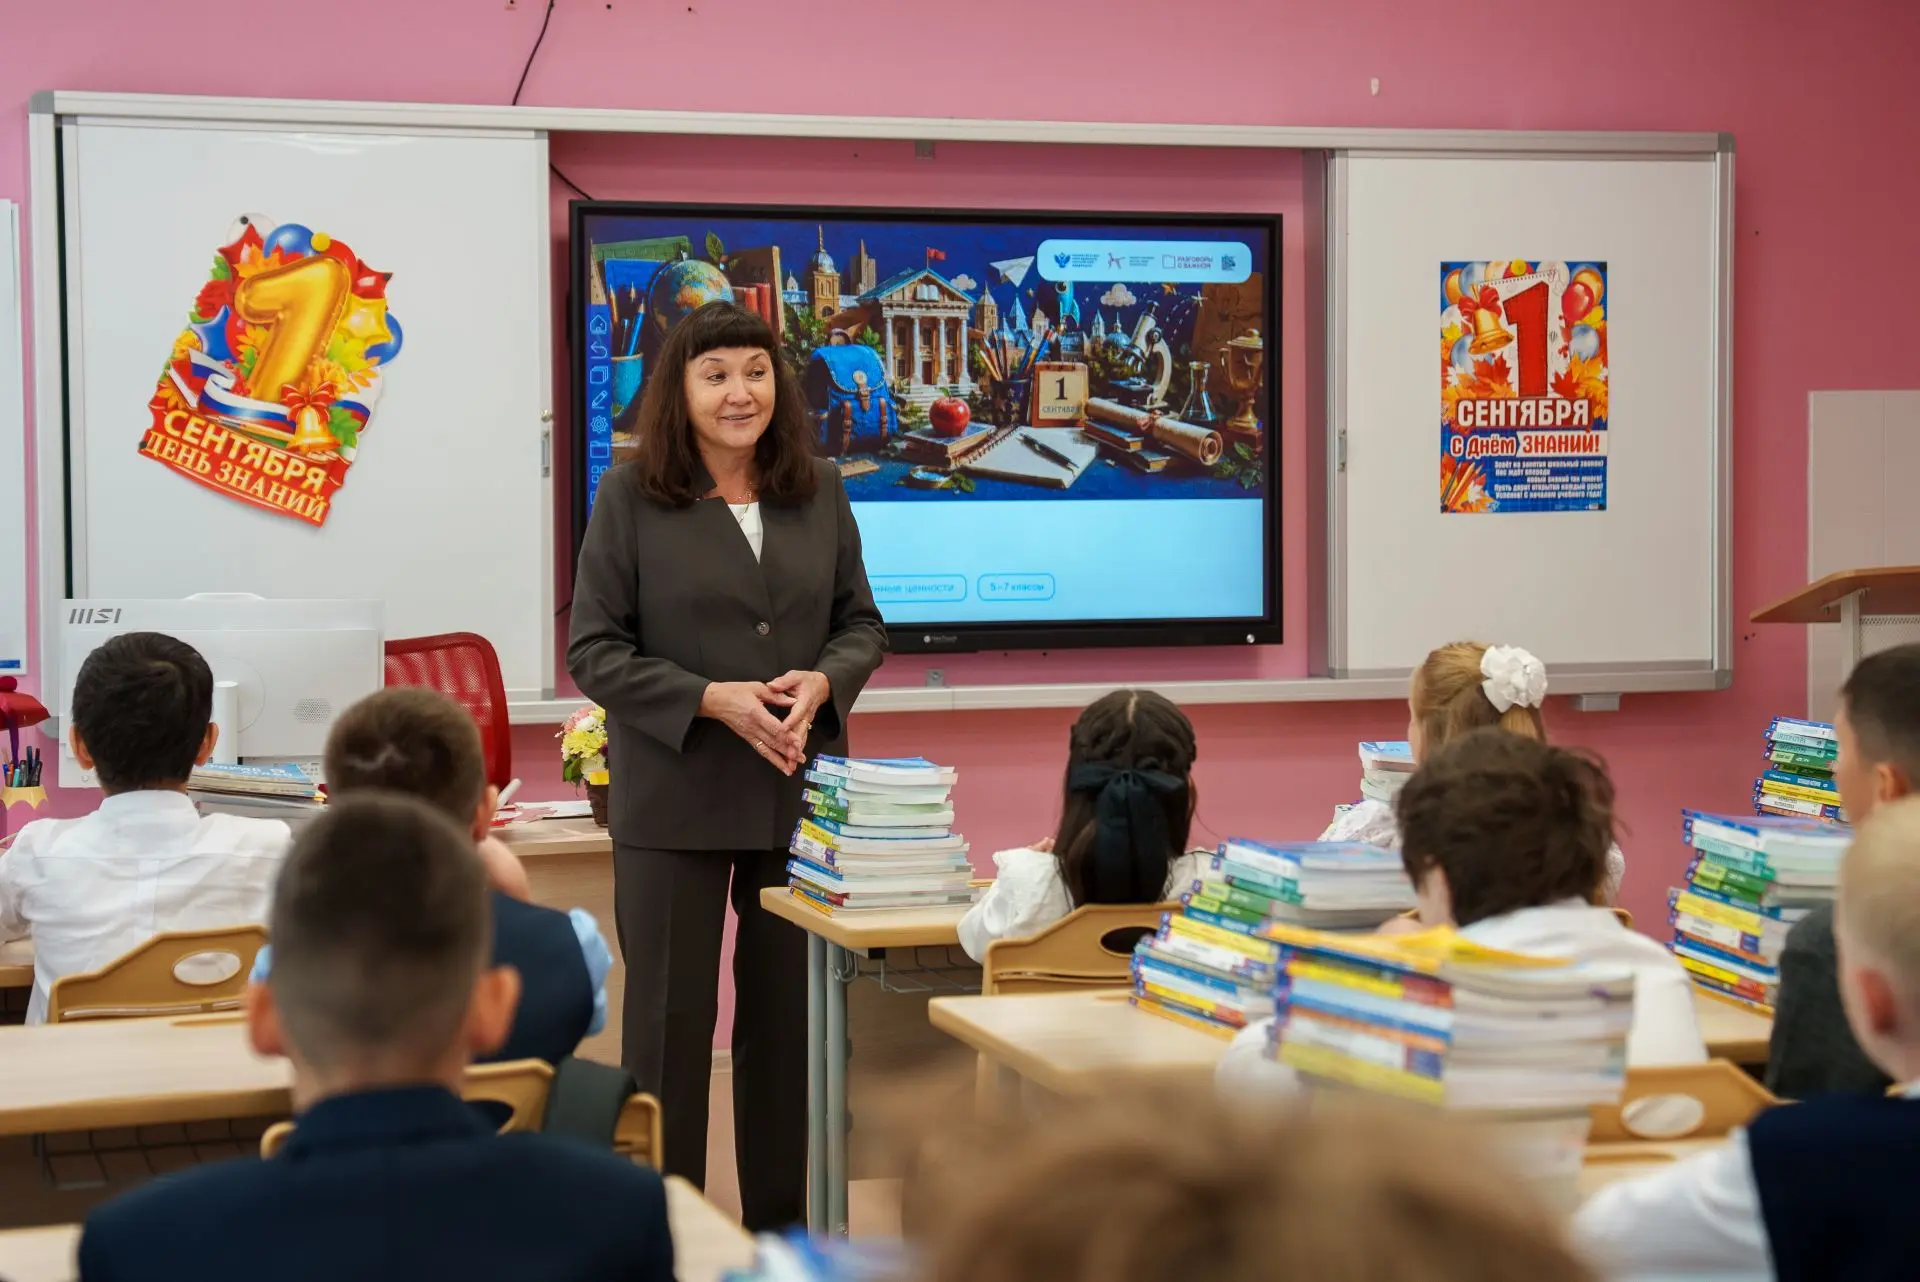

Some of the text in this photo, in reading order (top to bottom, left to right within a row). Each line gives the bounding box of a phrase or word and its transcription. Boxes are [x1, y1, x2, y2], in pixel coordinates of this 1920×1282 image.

[1502, 280, 1550, 398] 1
[1055, 376, 1068, 400] 1
[1457, 399, 1589, 427] СЕНТЯБРЯ
[163, 409, 328, 494] СЕНТЯБРЯ
[1450, 436, 1463, 456] С
[1522, 430, 1600, 454] ЗНАНИЙ!
[145, 430, 328, 523] ДЕНЬ ЗНАНИЙ
[68, 608, 122, 625] MSI
